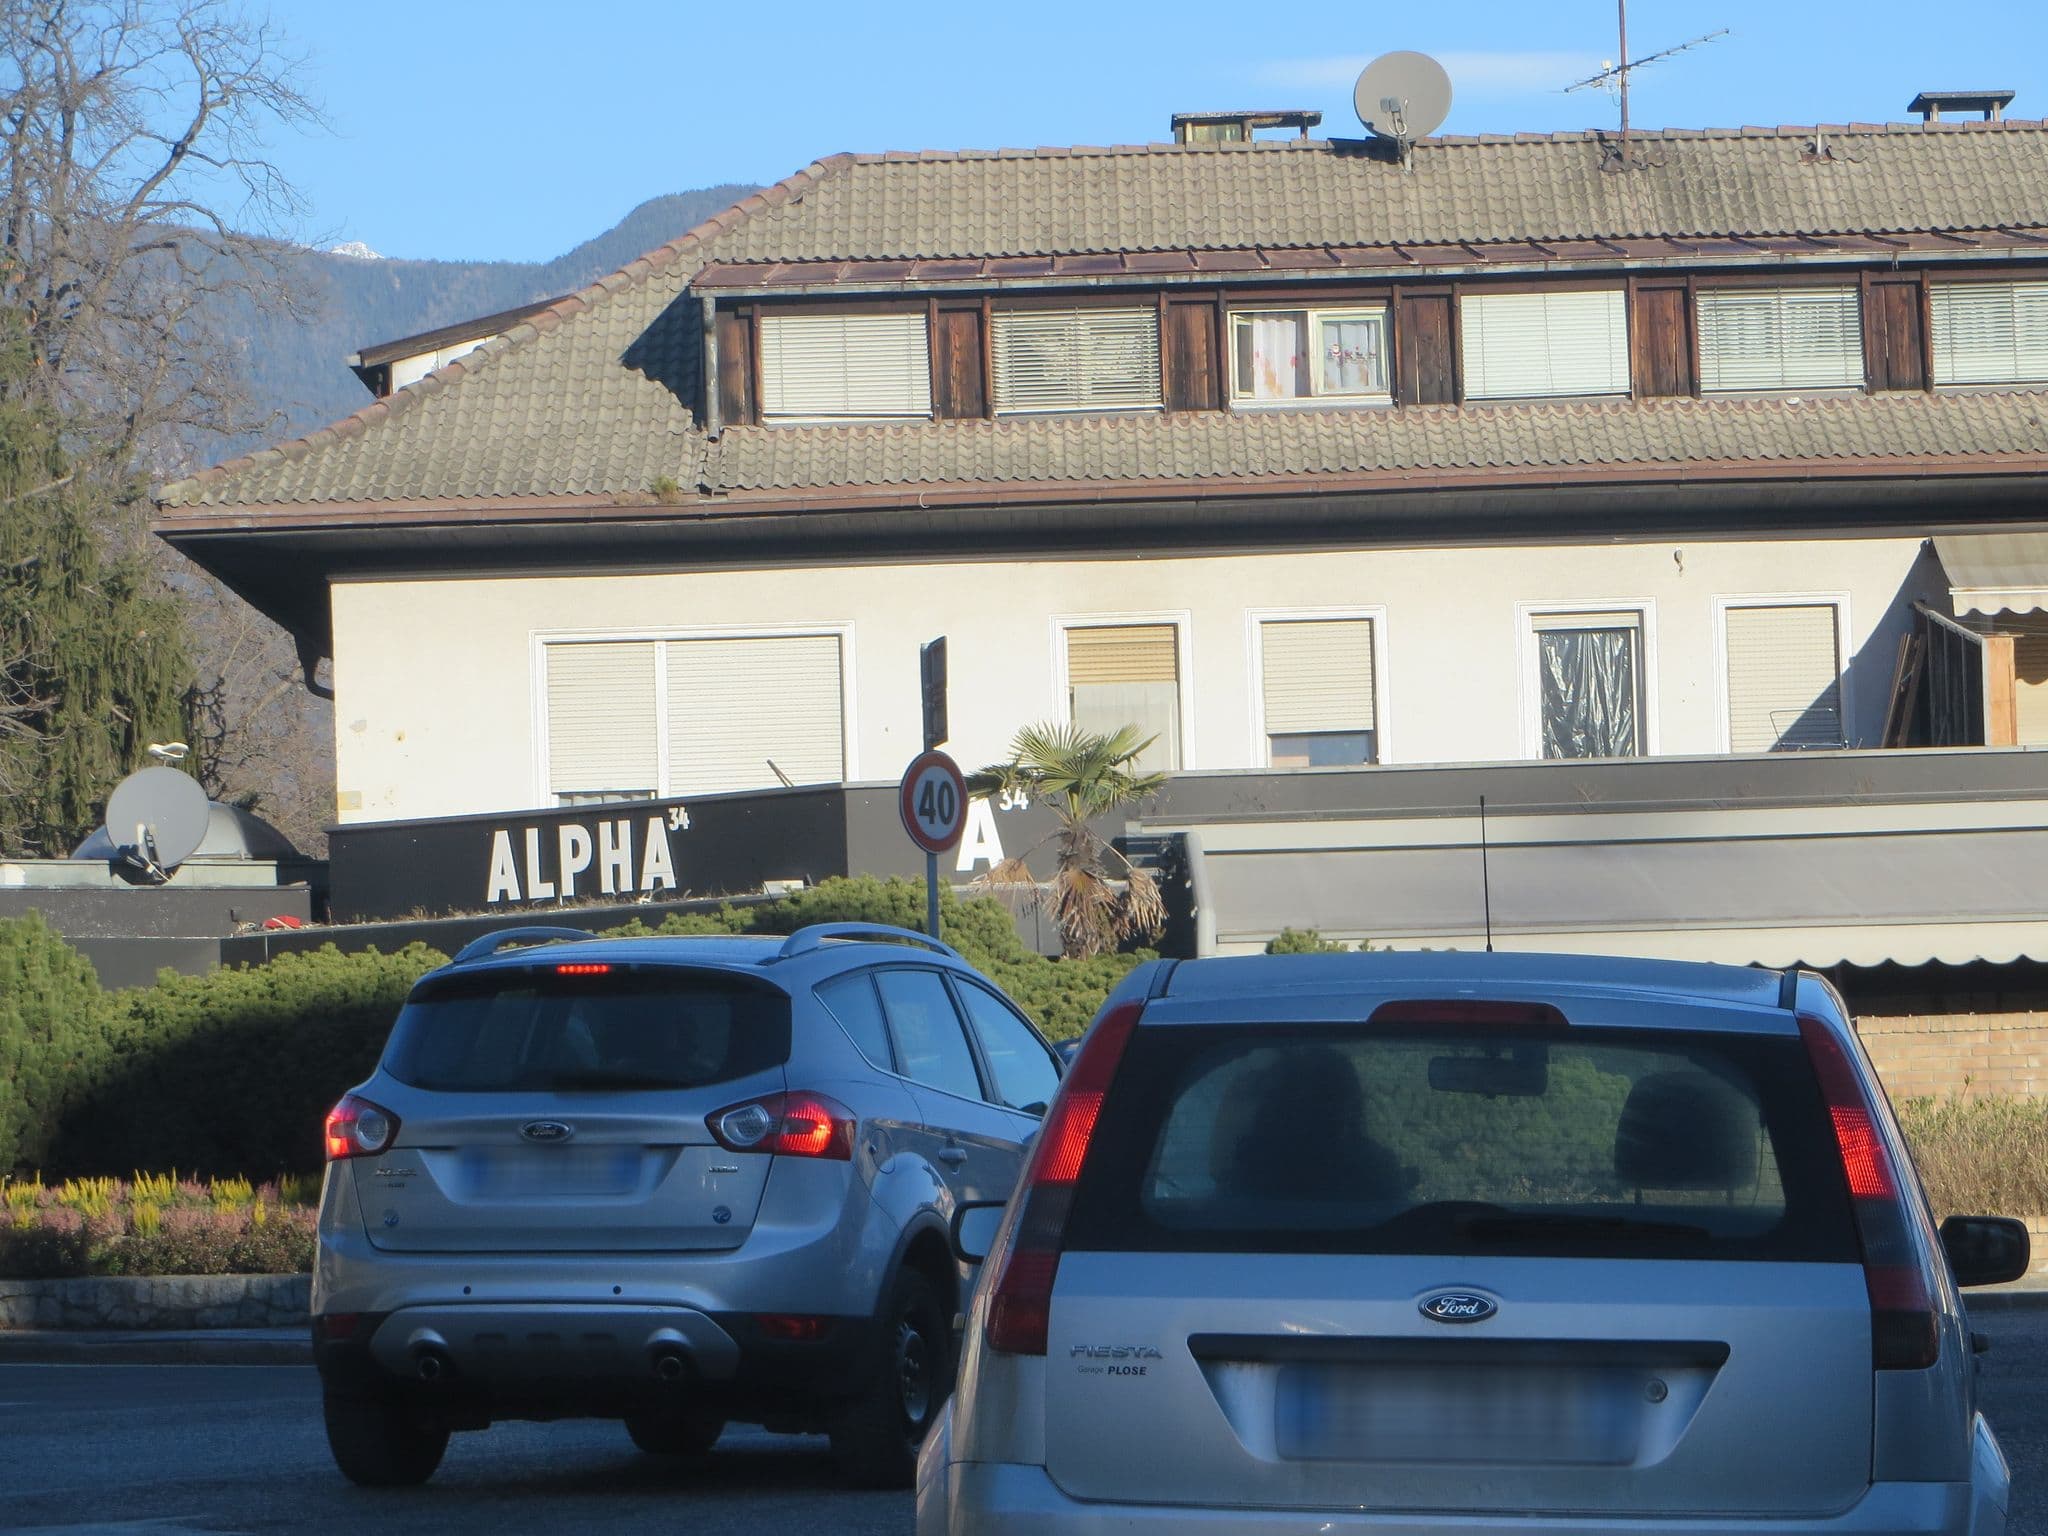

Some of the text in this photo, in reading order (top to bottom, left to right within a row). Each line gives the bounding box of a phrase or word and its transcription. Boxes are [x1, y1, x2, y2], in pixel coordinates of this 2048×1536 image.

[918, 779, 956, 826] 40
[955, 786, 1029, 872] A 34
[487, 806, 691, 903] ALPHA 34
[1436, 1296, 1479, 1314] Ford
[1070, 1344, 1163, 1359] FIESTA
[1107, 1366, 1148, 1376] PLOSE
